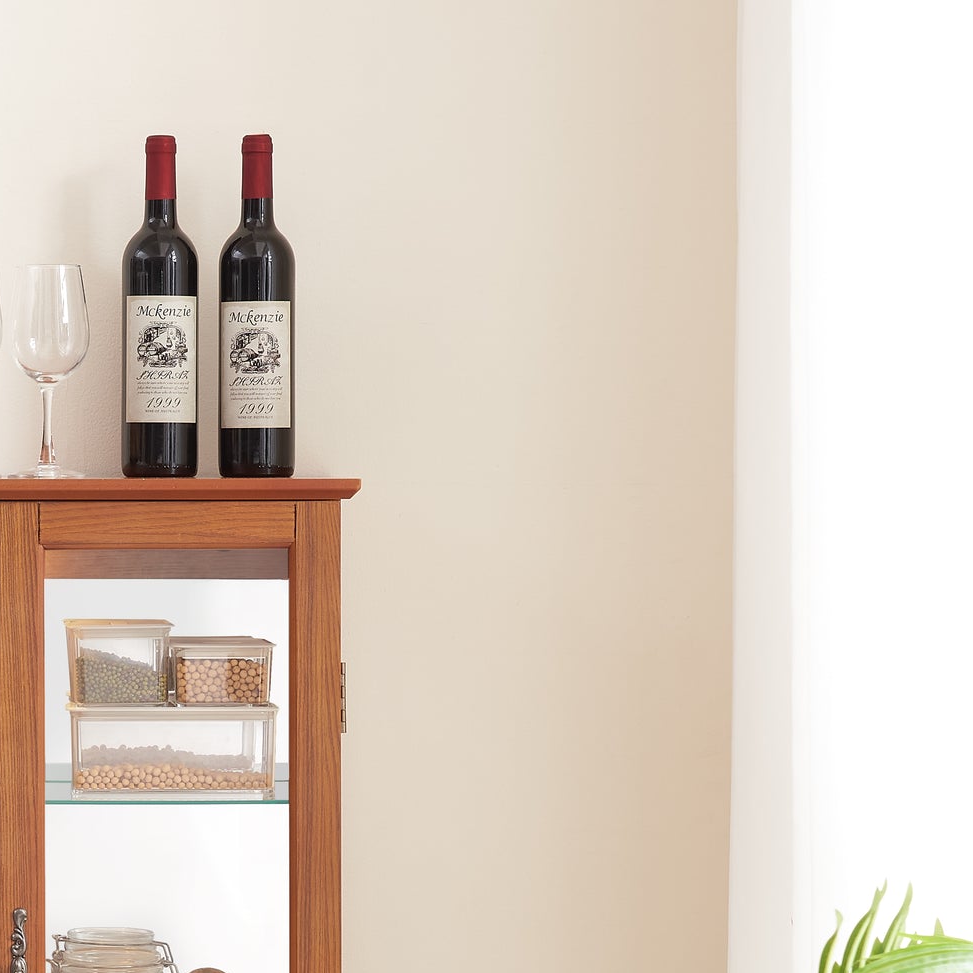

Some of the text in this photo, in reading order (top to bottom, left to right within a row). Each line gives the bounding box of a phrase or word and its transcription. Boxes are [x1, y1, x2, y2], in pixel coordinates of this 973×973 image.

[136, 304, 191, 320] Mckenzie
[228, 309, 284, 326] Mckenzie
[146, 397, 181, 408] 1999
[239, 403, 274, 414] 1999
